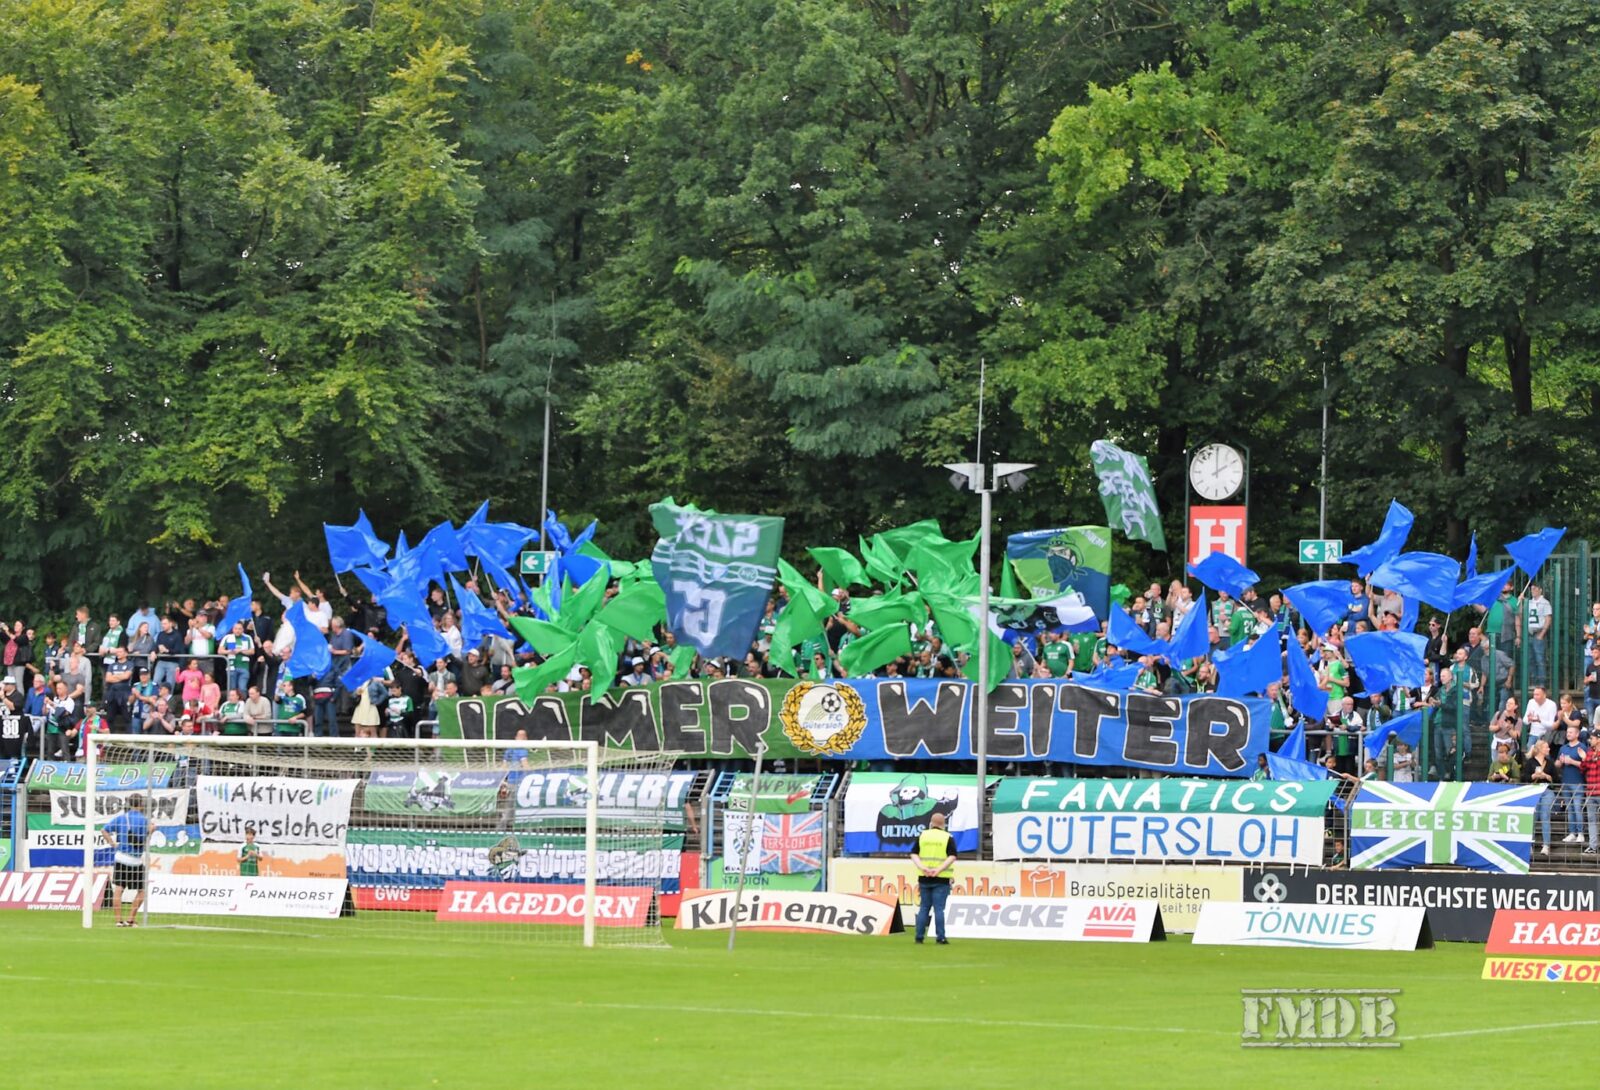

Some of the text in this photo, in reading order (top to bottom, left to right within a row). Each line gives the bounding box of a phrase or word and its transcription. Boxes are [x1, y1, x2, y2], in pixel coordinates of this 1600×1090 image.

[1193, 518, 1243, 566] H
[457, 679, 1251, 773] IMMER WEITER
[36, 765, 167, 786] RHEDA
[231, 782, 313, 805] Aktive
[517, 772, 694, 808] GT LEBT
[1019, 780, 1304, 812] FANATICS
[202, 811, 347, 839] Gütersloher
[881, 824, 926, 838] ULTRAS
[1365, 810, 1521, 834] LEICESTER
[1016, 815, 1299, 858] GÜTERSLOH
[346, 839, 681, 879] VORWÄRTS GÜTERSLOH
[0, 872, 108, 903] MEN
[151, 886, 235, 898] PANNHORST
[250, 889, 335, 902] PANNHORST
[375, 888, 411, 901] GWG
[1070, 881, 1211, 900] BrauSpezialitäten
[1315, 885, 1594, 913] DER EINFACHSTE WEG ZUM
[27, 903, 84, 911] www.kahmen.
[447, 890, 641, 920] HAGEDORN
[691, 895, 877, 935] Kleinemas
[1087, 903, 1137, 922] AVIA
[1162, 903, 1183, 914] seit
[1244, 907, 1377, 937] TÖNNIES
[1509, 922, 1600, 945] HAGE
